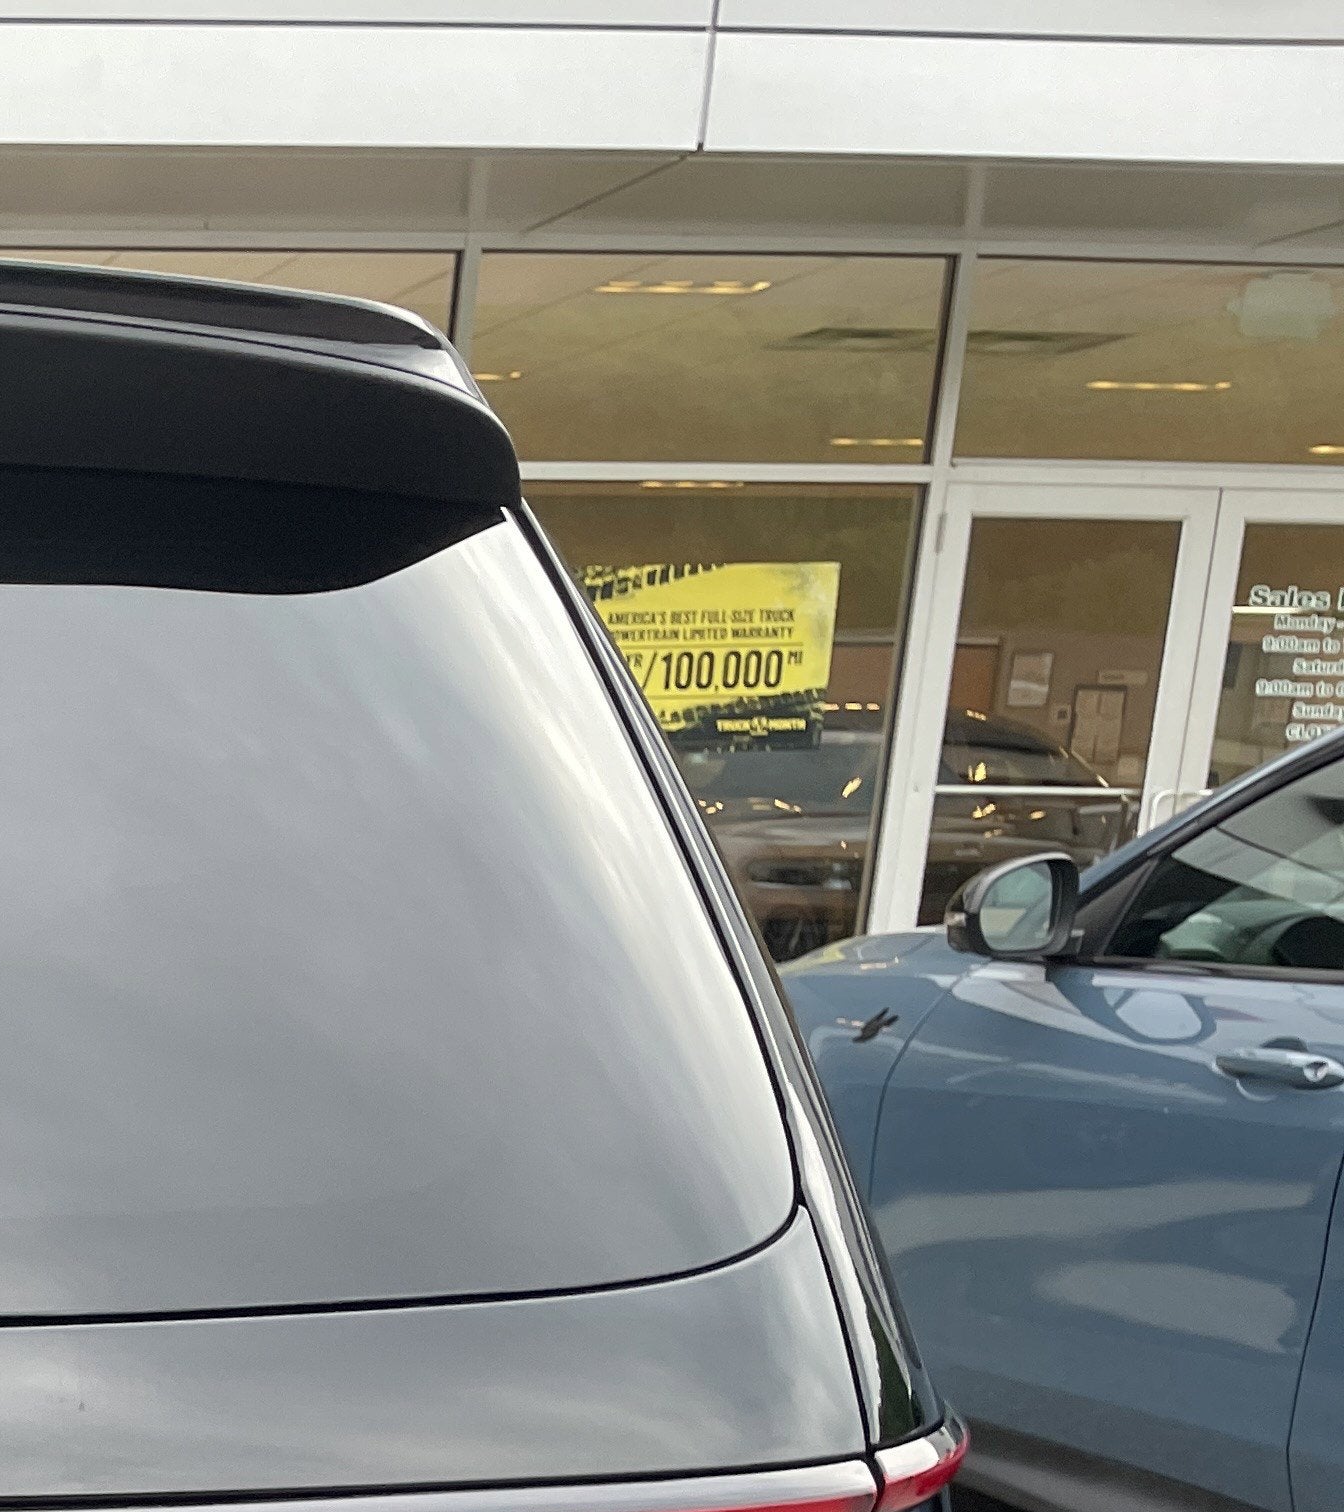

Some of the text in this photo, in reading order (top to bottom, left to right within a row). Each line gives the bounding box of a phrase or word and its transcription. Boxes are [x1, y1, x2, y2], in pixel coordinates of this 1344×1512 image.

[1249, 584, 1330, 611] Sales
[670, 609, 697, 624] BEST
[758, 608, 794, 622] TRUCK
[1274, 613, 1336, 634] Monday
[731, 627, 793, 639] WARRANTY
